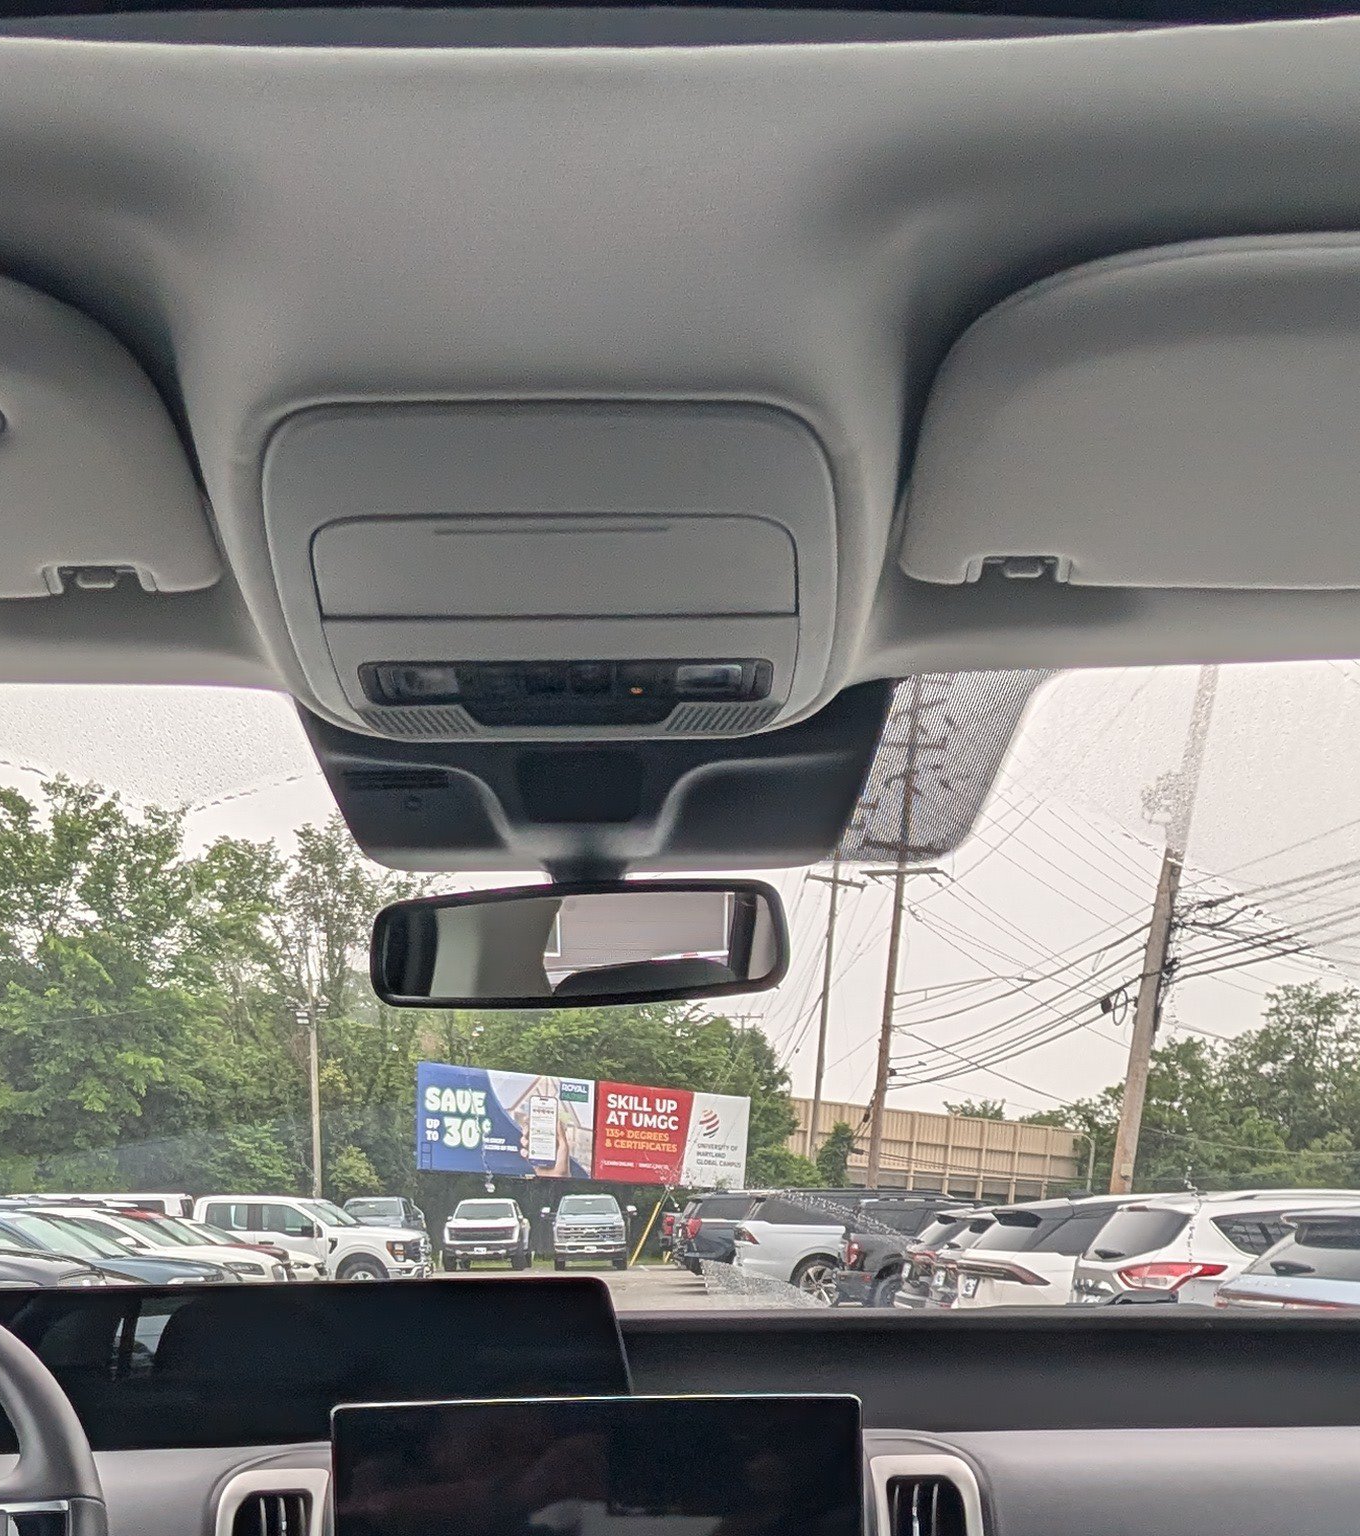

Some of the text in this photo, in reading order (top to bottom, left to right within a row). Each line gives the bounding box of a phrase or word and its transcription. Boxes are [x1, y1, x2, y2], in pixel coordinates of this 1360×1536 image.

[561, 1083, 588, 1094] ROYAL
[425, 1086, 486, 1115] SAVE
[607, 1093, 652, 1112] SKILL
[655, 1098, 678, 1114] UP
[426, 1118, 440, 1129] UP
[606, 1111, 679, 1131] AT UMGC
[425, 1130, 439, 1142] TO
[626, 1130, 669, 1142] DEGREES
[613, 1140, 678, 1153] CERTIFICATES
